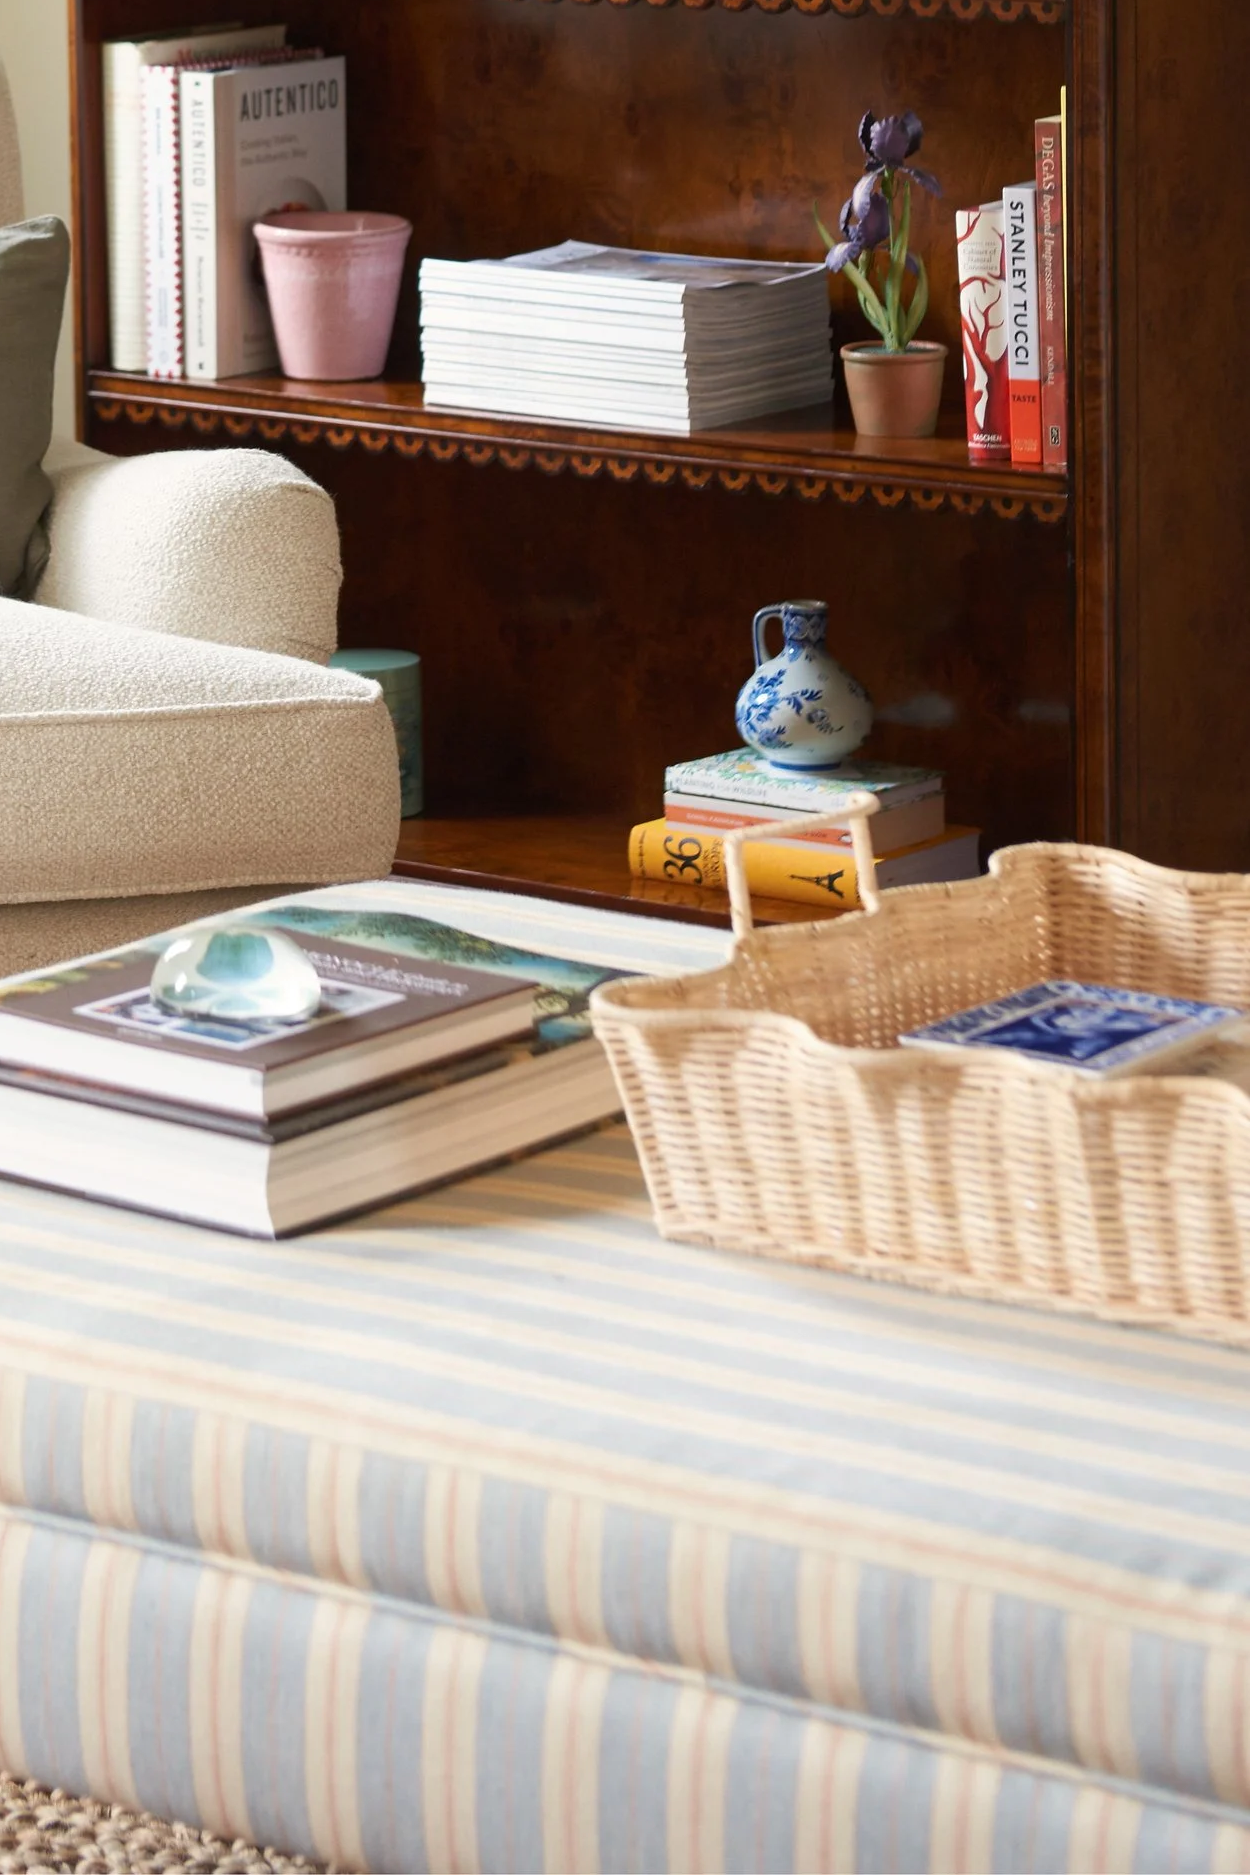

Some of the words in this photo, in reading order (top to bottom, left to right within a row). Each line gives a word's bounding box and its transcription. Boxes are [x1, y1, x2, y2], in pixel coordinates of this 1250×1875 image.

[240, 78, 339, 122] AUTENTICO
[190, 99, 206, 187] AUTENTICO
[1041, 136, 1055, 191] DEGAS
[1042, 195, 1054, 237] beyond
[1010, 201, 1027, 296] STANLEY
[1042, 237, 1055, 321] Impressionism
[1013, 301, 1029, 367] TUCCI
[1047, 345, 1055, 386] KENDALL
[1012, 394, 1037, 403] TASTE
[663, 835, 703, 885] 36
